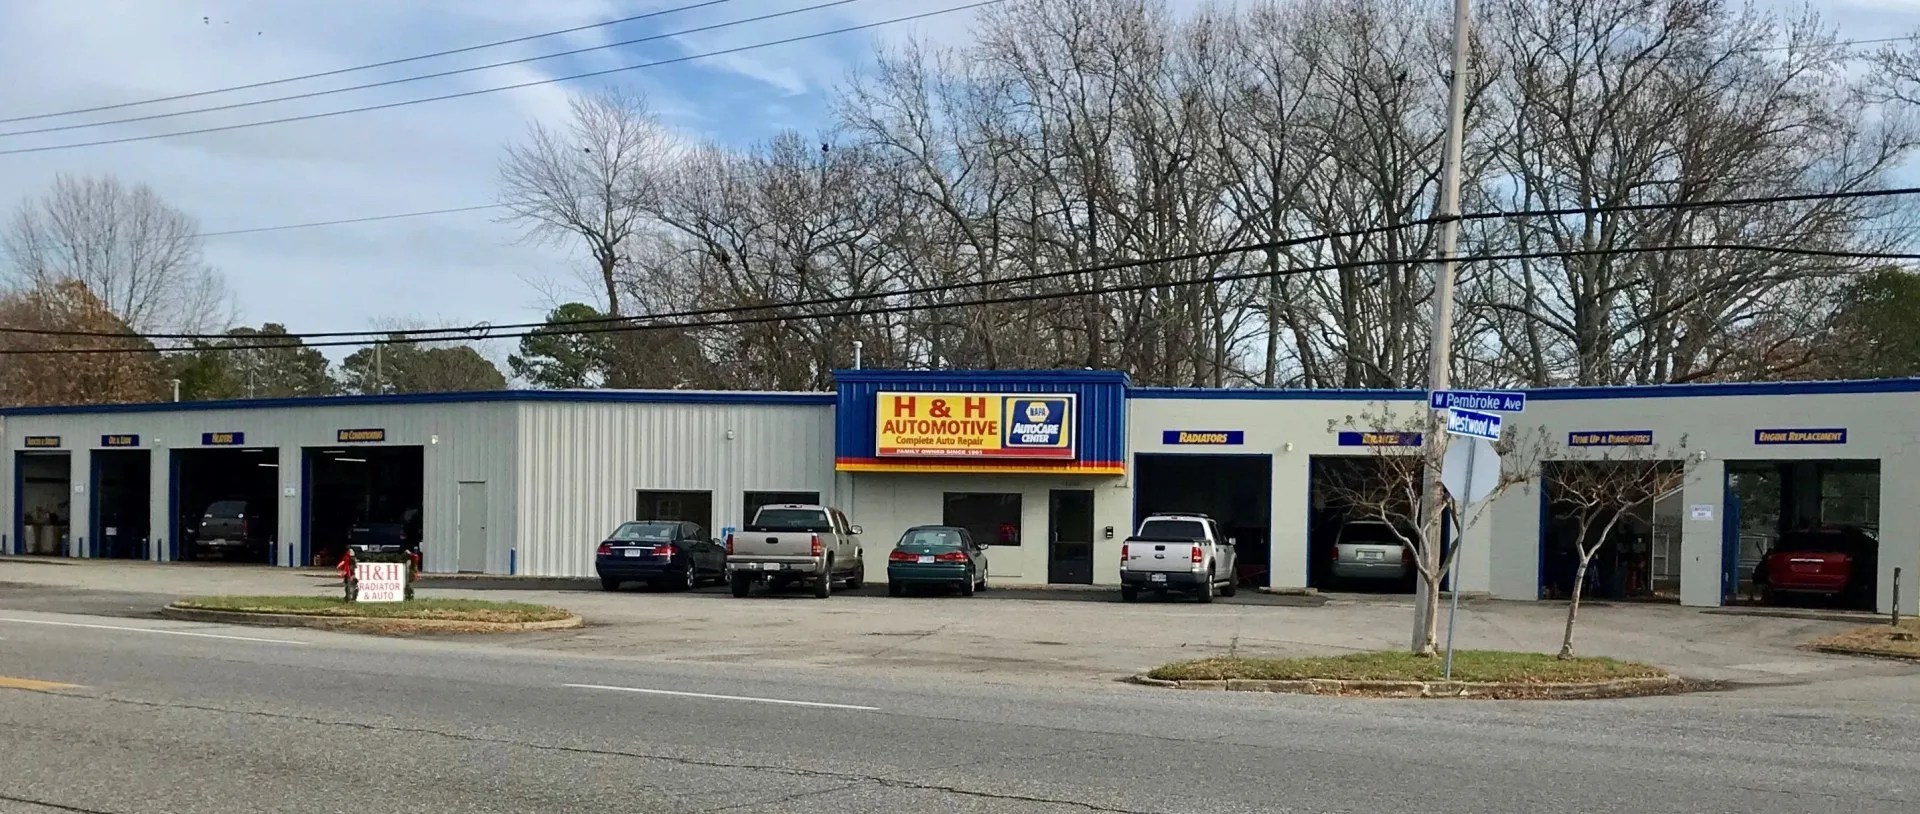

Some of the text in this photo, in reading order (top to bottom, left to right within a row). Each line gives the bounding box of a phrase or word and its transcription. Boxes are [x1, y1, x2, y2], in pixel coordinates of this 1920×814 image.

[894, 396, 986, 418] H & H
[1435, 393, 1522, 410] W Pembroke Ave
[1030, 407, 1046, 416] NAPA
[882, 419, 998, 436] AUTOMOTIVE
[1448, 411, 1500, 436] Westwood Ave
[895, 435, 984, 447] Complete Auto Repair
[1021, 434, 1050, 443] CENTER
[359, 582, 400, 592] RADIATOR
[363, 591, 394, 600] & AUTO
